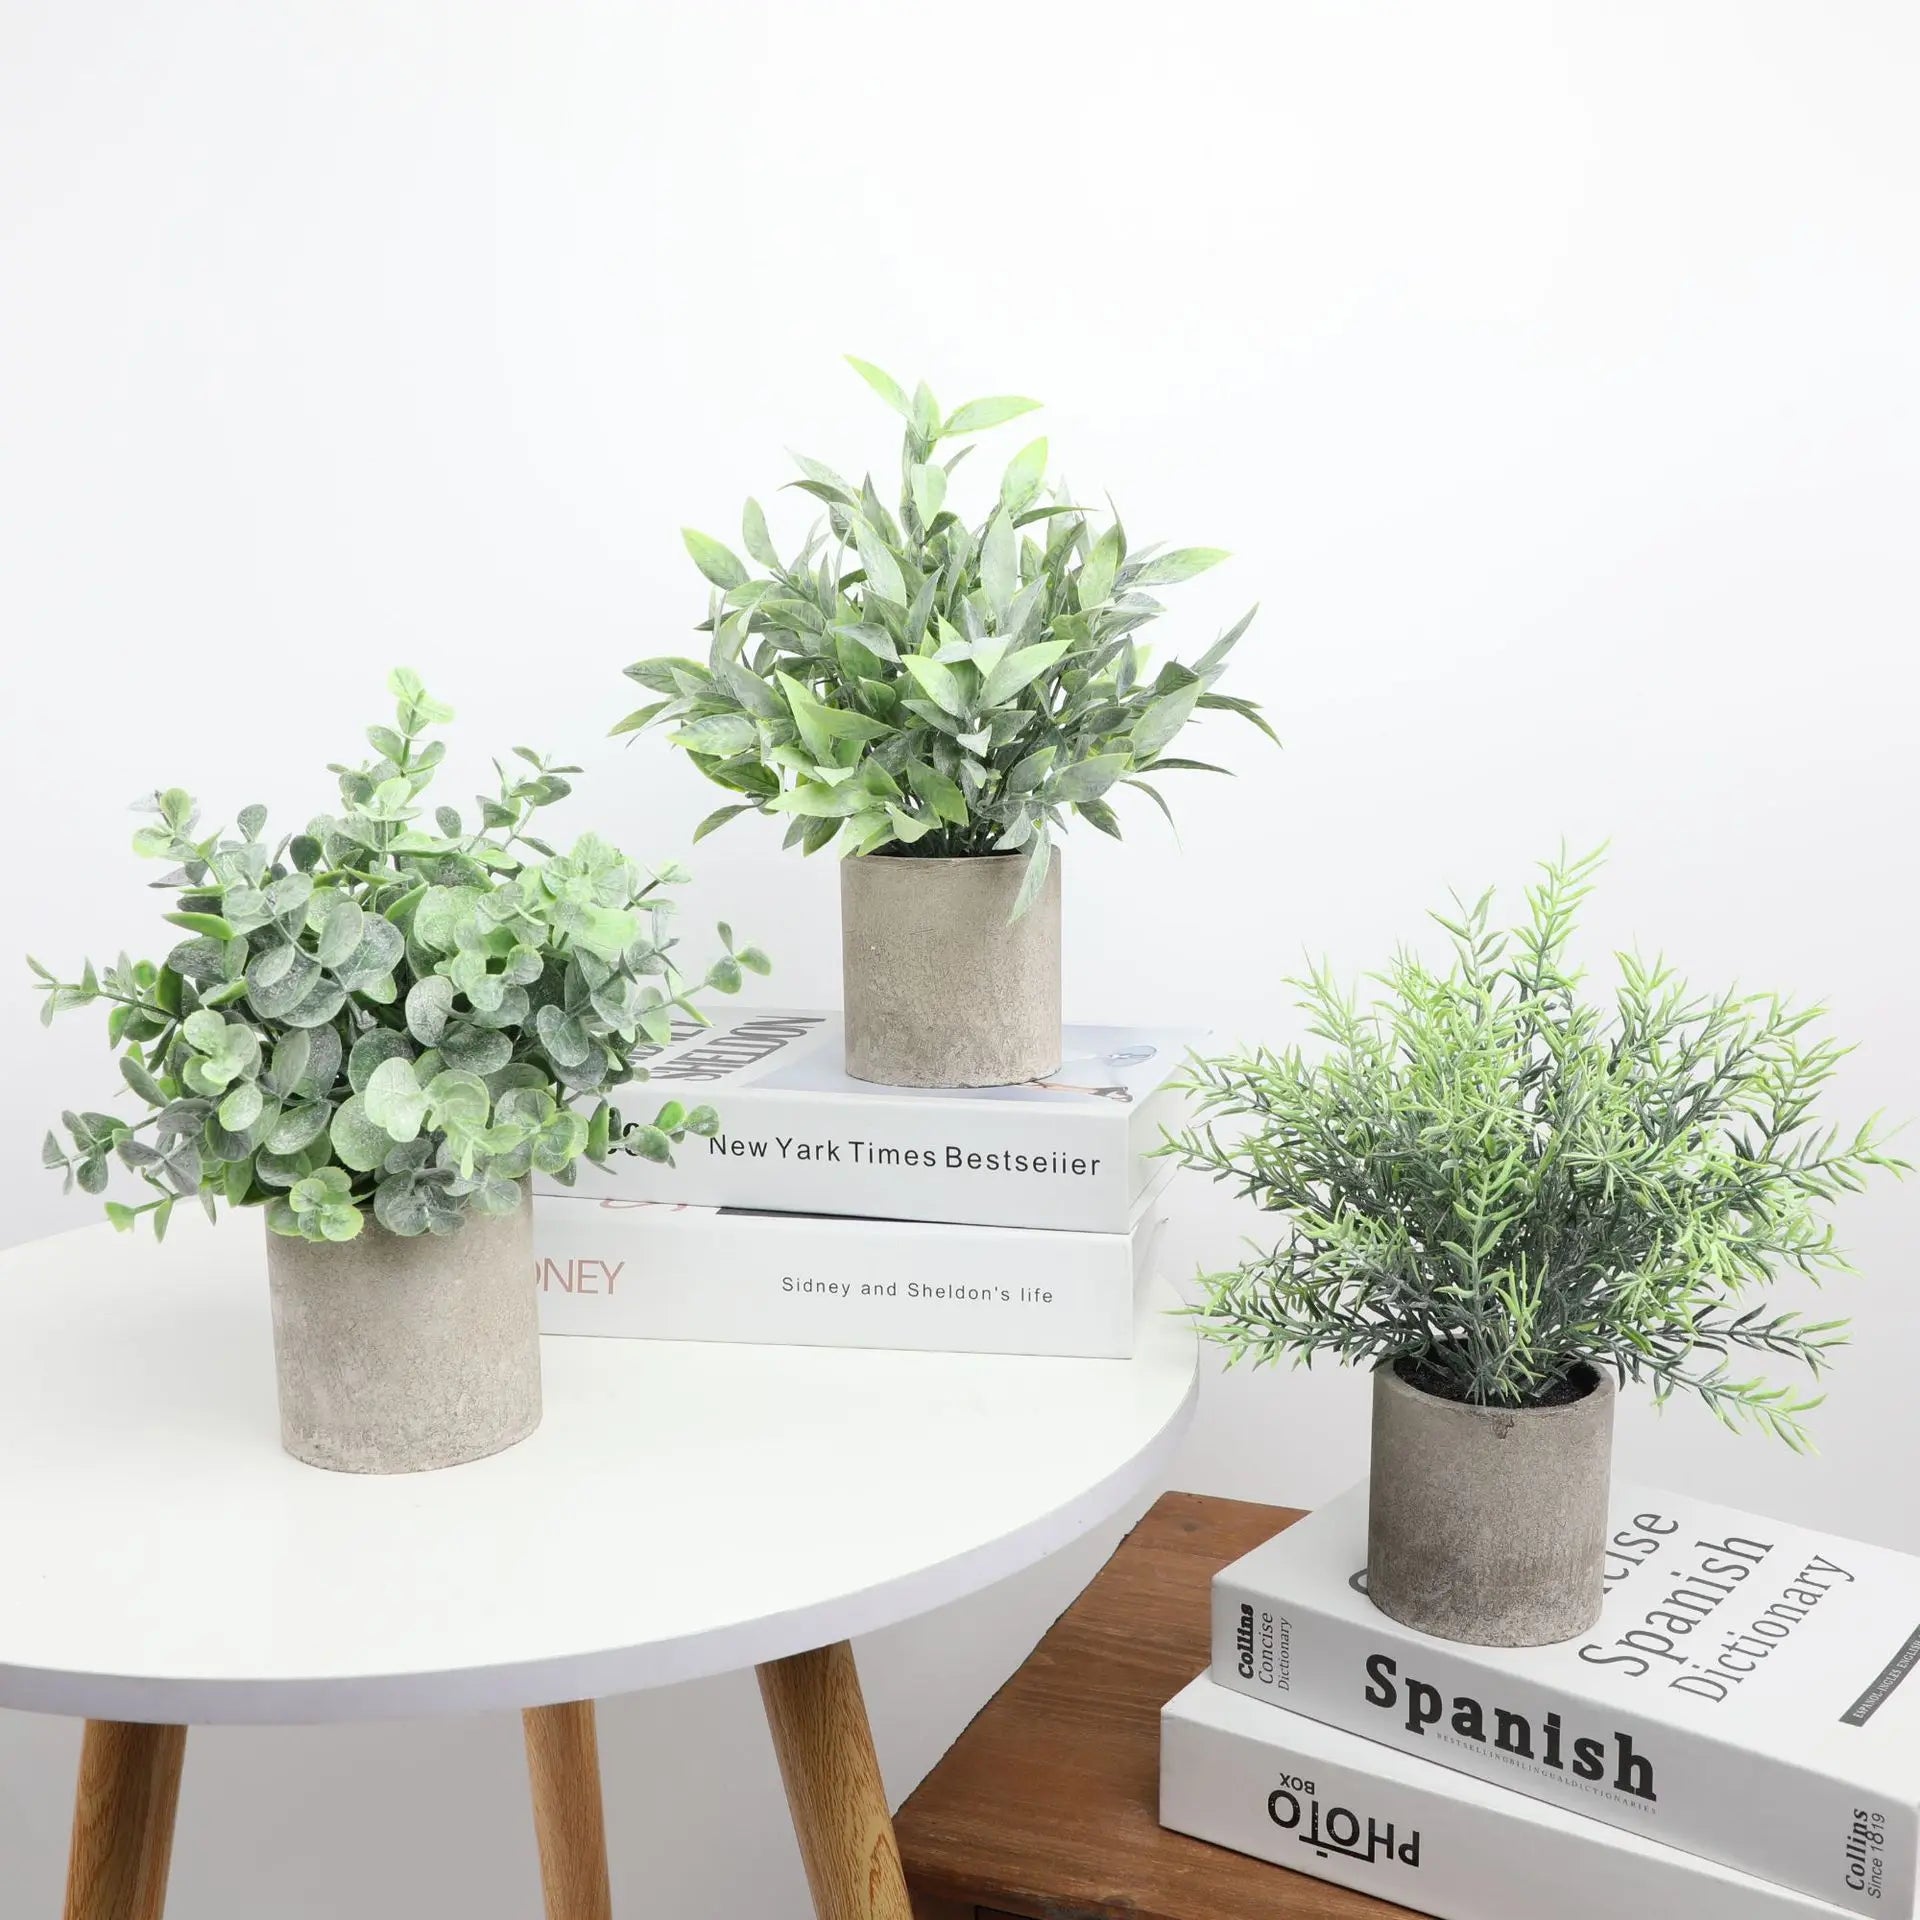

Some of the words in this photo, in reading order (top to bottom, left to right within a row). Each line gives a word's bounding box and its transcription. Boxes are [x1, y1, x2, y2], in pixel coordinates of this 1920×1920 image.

[650, 1015, 824, 1082] SHELDON
[709, 1134, 768, 1158] New
[776, 1136, 841, 1163] Yark
[848, 1141, 937, 1168] Times
[535, 1257, 626, 1295] NEY
[782, 1277, 850, 1298] Sidney
[861, 1282, 897, 1296] and
[908, 1282, 1010, 1302] Sheldon's
[1020, 1287, 1053, 1303] life
[1236, 1603, 1255, 1679] Collins
[1578, 1536, 1775, 1677] Spanish
[1668, 1554, 1855, 1703] Dictionary
[1258, 1612, 1274, 1685] Concise
[1278, 1617, 1292, 1692] Dictionary
[1365, 1653, 1657, 1801] Spanish
[1279, 1772, 1315, 1795] BOX
[1267, 1789, 1420, 1868] PHOTO
[1845, 1808, 1868, 1891] Collins
[1865, 1812, 1886, 1852] 1819
[1867, 1858, 1883, 1899] Since
